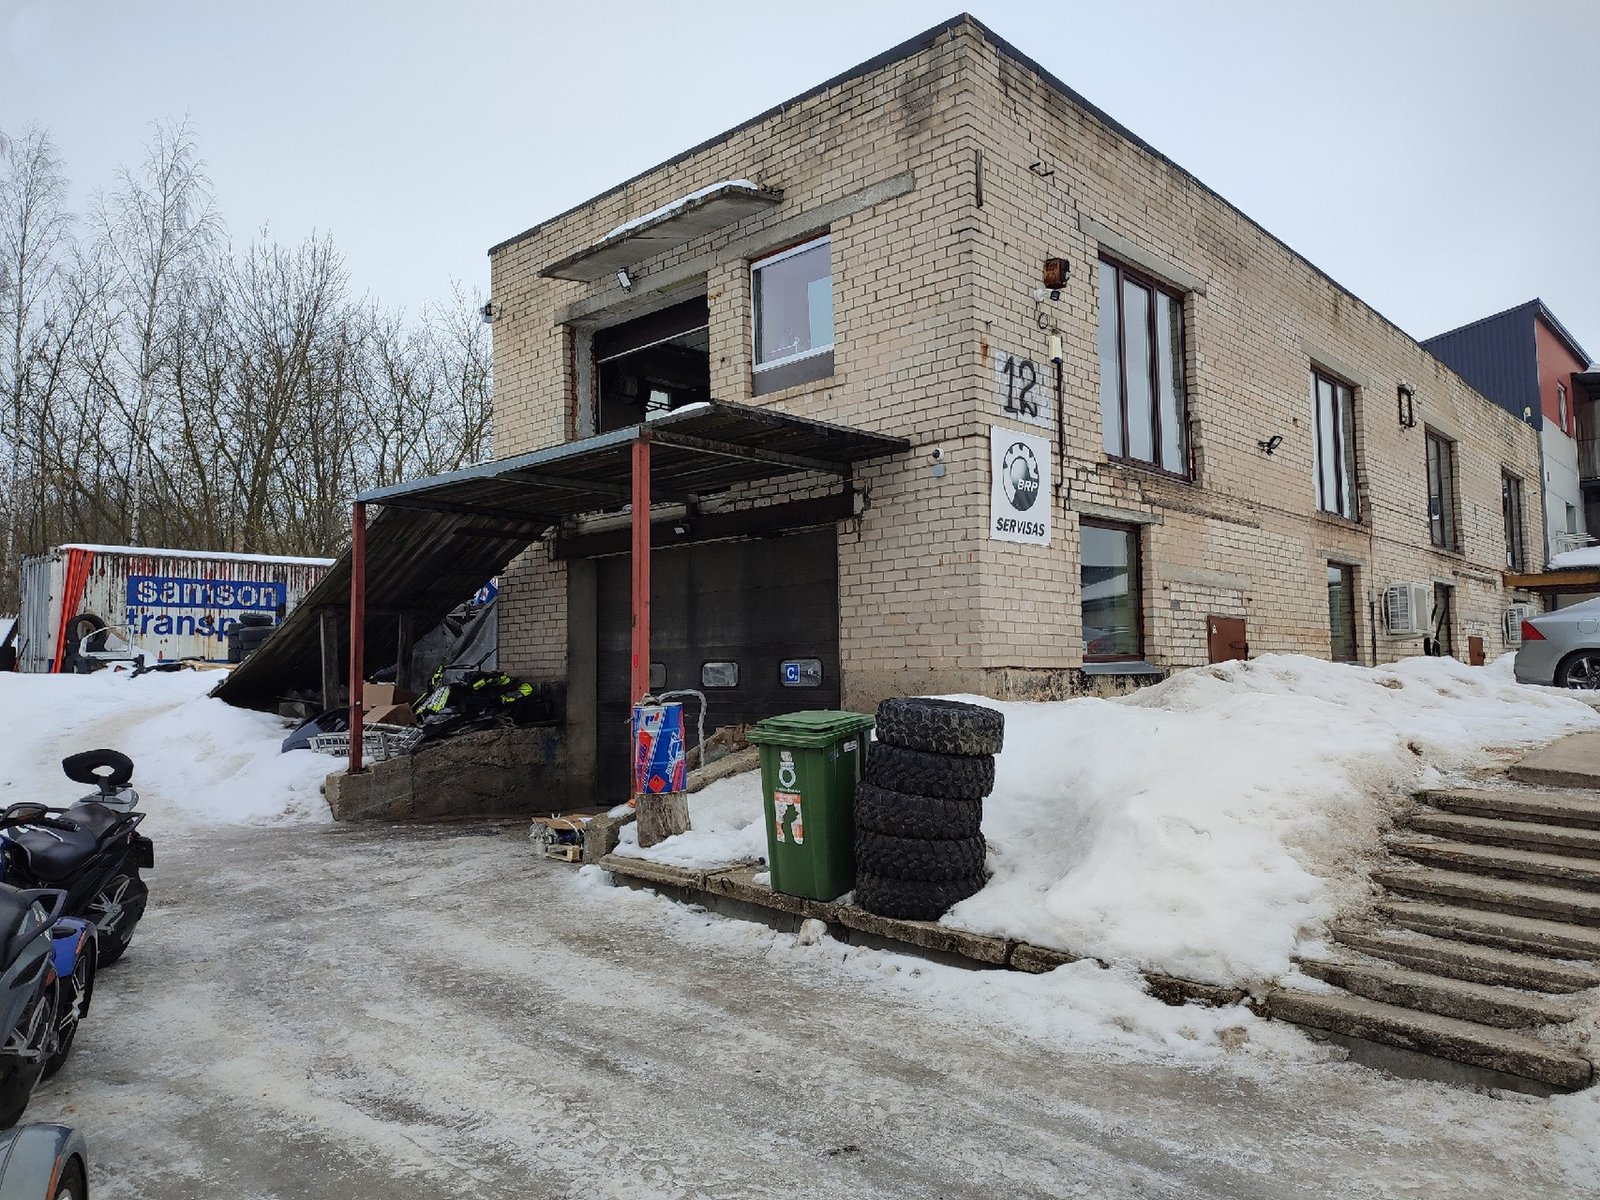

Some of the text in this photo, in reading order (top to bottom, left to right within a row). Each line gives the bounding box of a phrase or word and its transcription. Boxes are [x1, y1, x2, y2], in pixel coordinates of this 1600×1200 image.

[1003, 355, 1038, 418] 12
[1017, 478, 1038, 493] BRP
[995, 517, 1046, 537] SERVISAS
[137, 580, 278, 607] samson
[126, 607, 283, 642] transp
